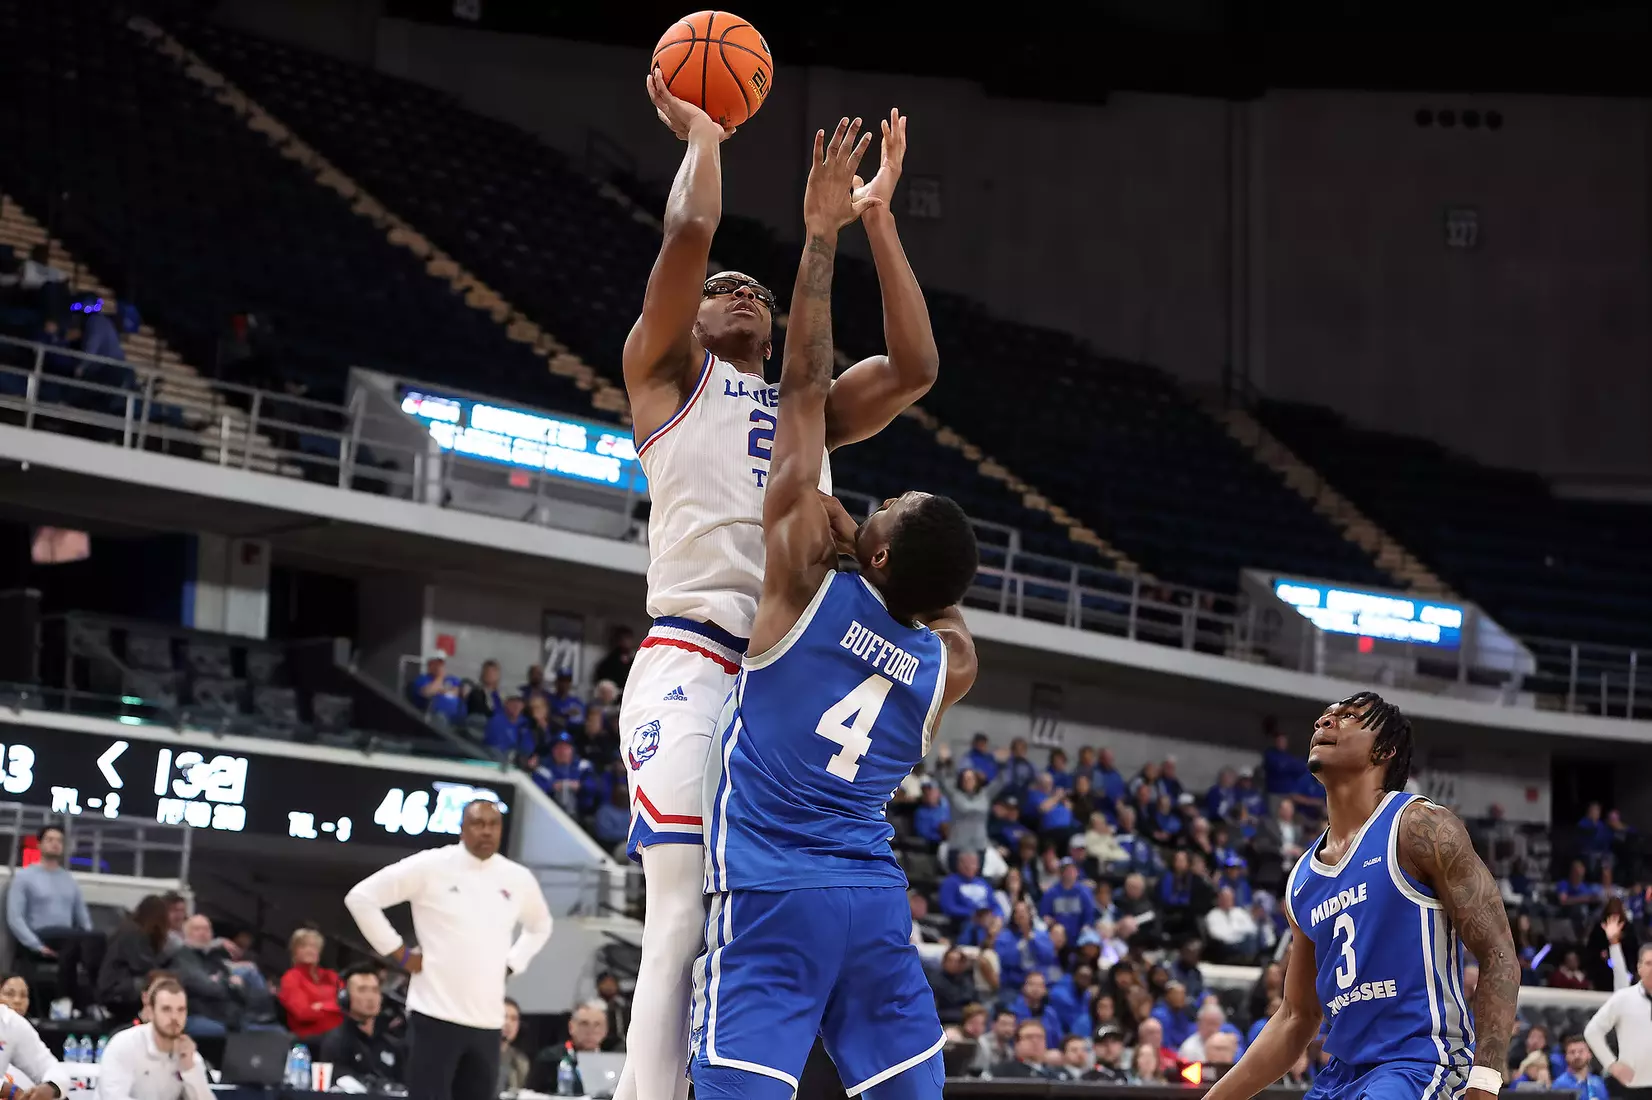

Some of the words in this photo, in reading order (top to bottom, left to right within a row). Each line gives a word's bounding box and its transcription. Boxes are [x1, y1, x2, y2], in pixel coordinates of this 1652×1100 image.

[839, 619, 920, 686] BUFFORD
[814, 673, 894, 783] 4
[0, 743, 35, 794] 3
[374, 788, 430, 836] 46
[1310, 882, 1368, 927] MIDDLE
[1332, 912, 1357, 990] 3
